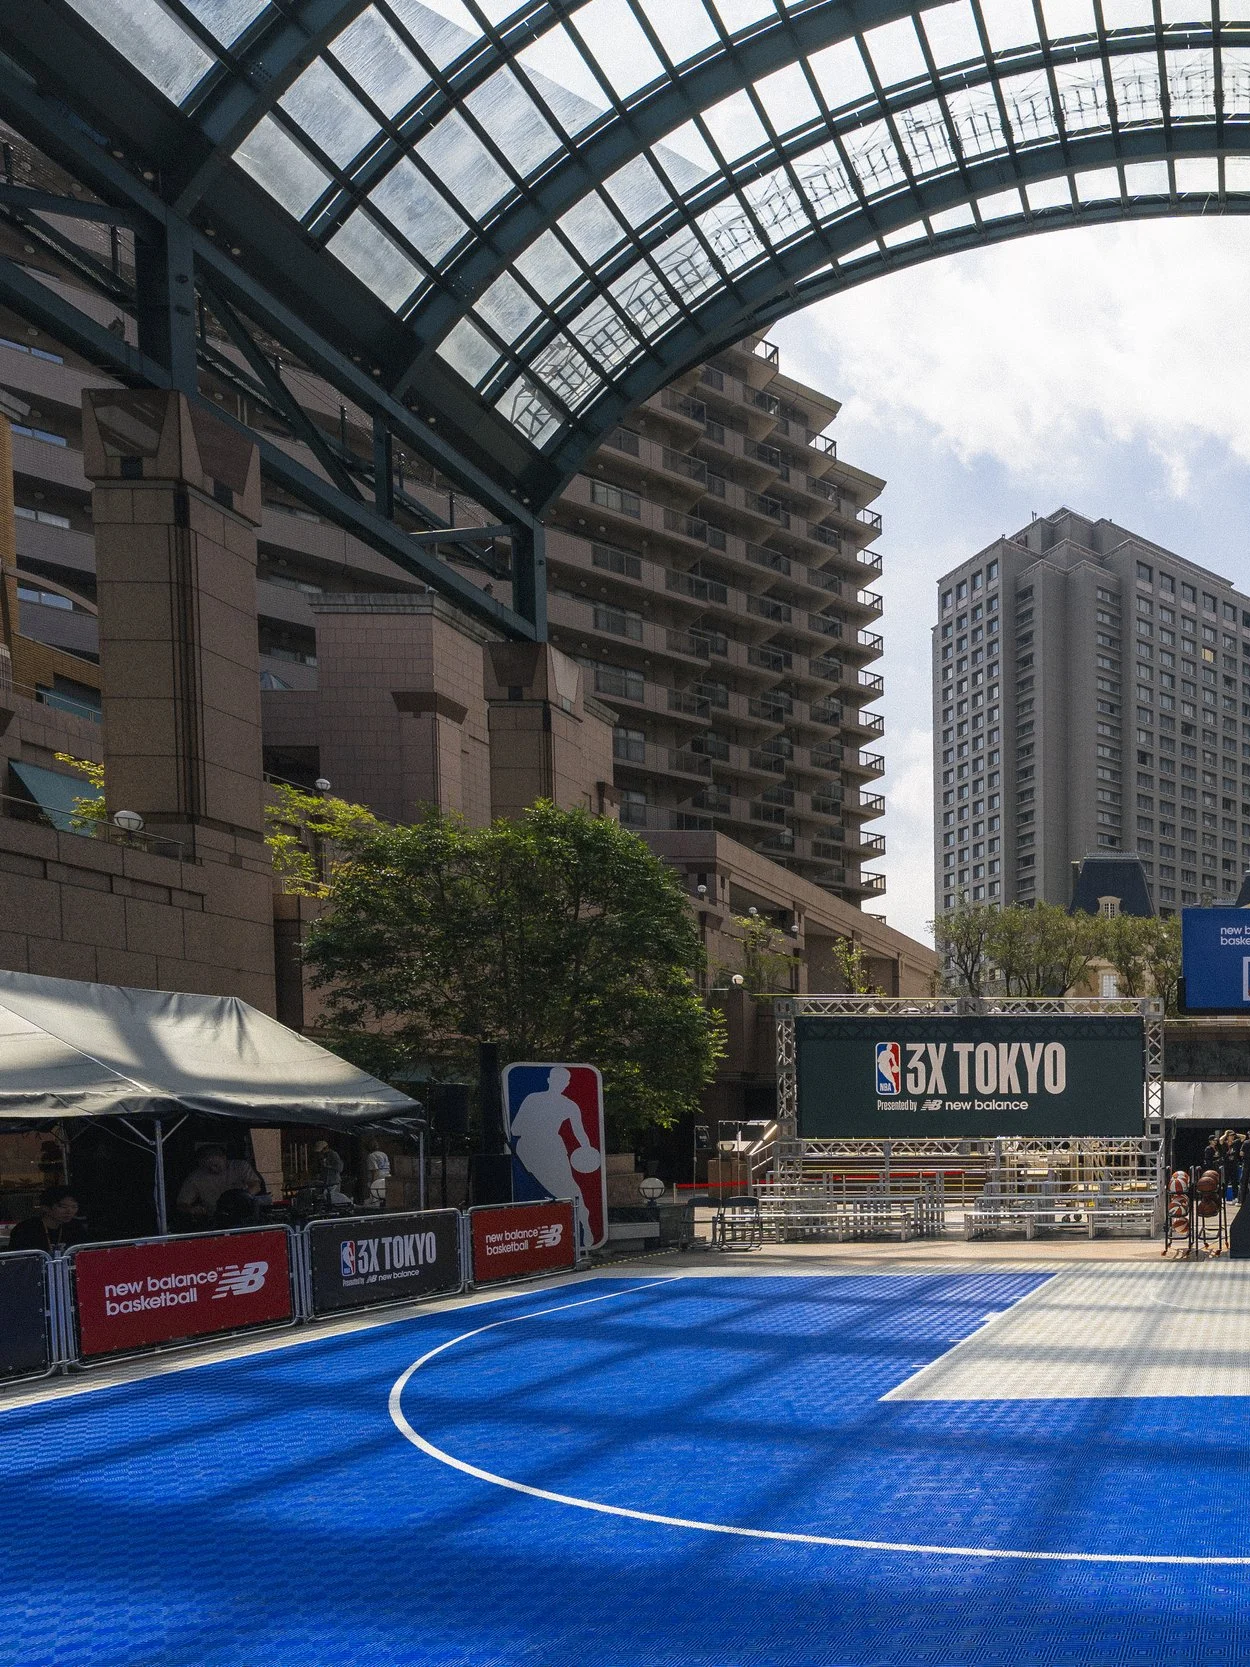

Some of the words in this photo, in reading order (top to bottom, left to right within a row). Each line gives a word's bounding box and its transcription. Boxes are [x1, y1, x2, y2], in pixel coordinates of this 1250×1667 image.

[906, 1043, 947, 1095] 3X
[953, 1042, 1066, 1094] TOKYO
[880, 1083, 892, 1092] NBA
[877, 1100, 909, 1110] Presented
[909, 1100, 917, 1112] by
[946, 1101, 972, 1110] new
[975, 1100, 1028, 1110] balance
[486, 1234, 504, 1243] new
[358, 1239, 380, 1274] 3X
[382, 1232, 436, 1270] TOKYO
[487, 1240, 528, 1256] basketball
[211, 1261, 268, 1300] NB
[393, 1270, 419, 1279] balance
[105, 1280, 143, 1297] new
[106, 1288, 197, 1316] basketball
